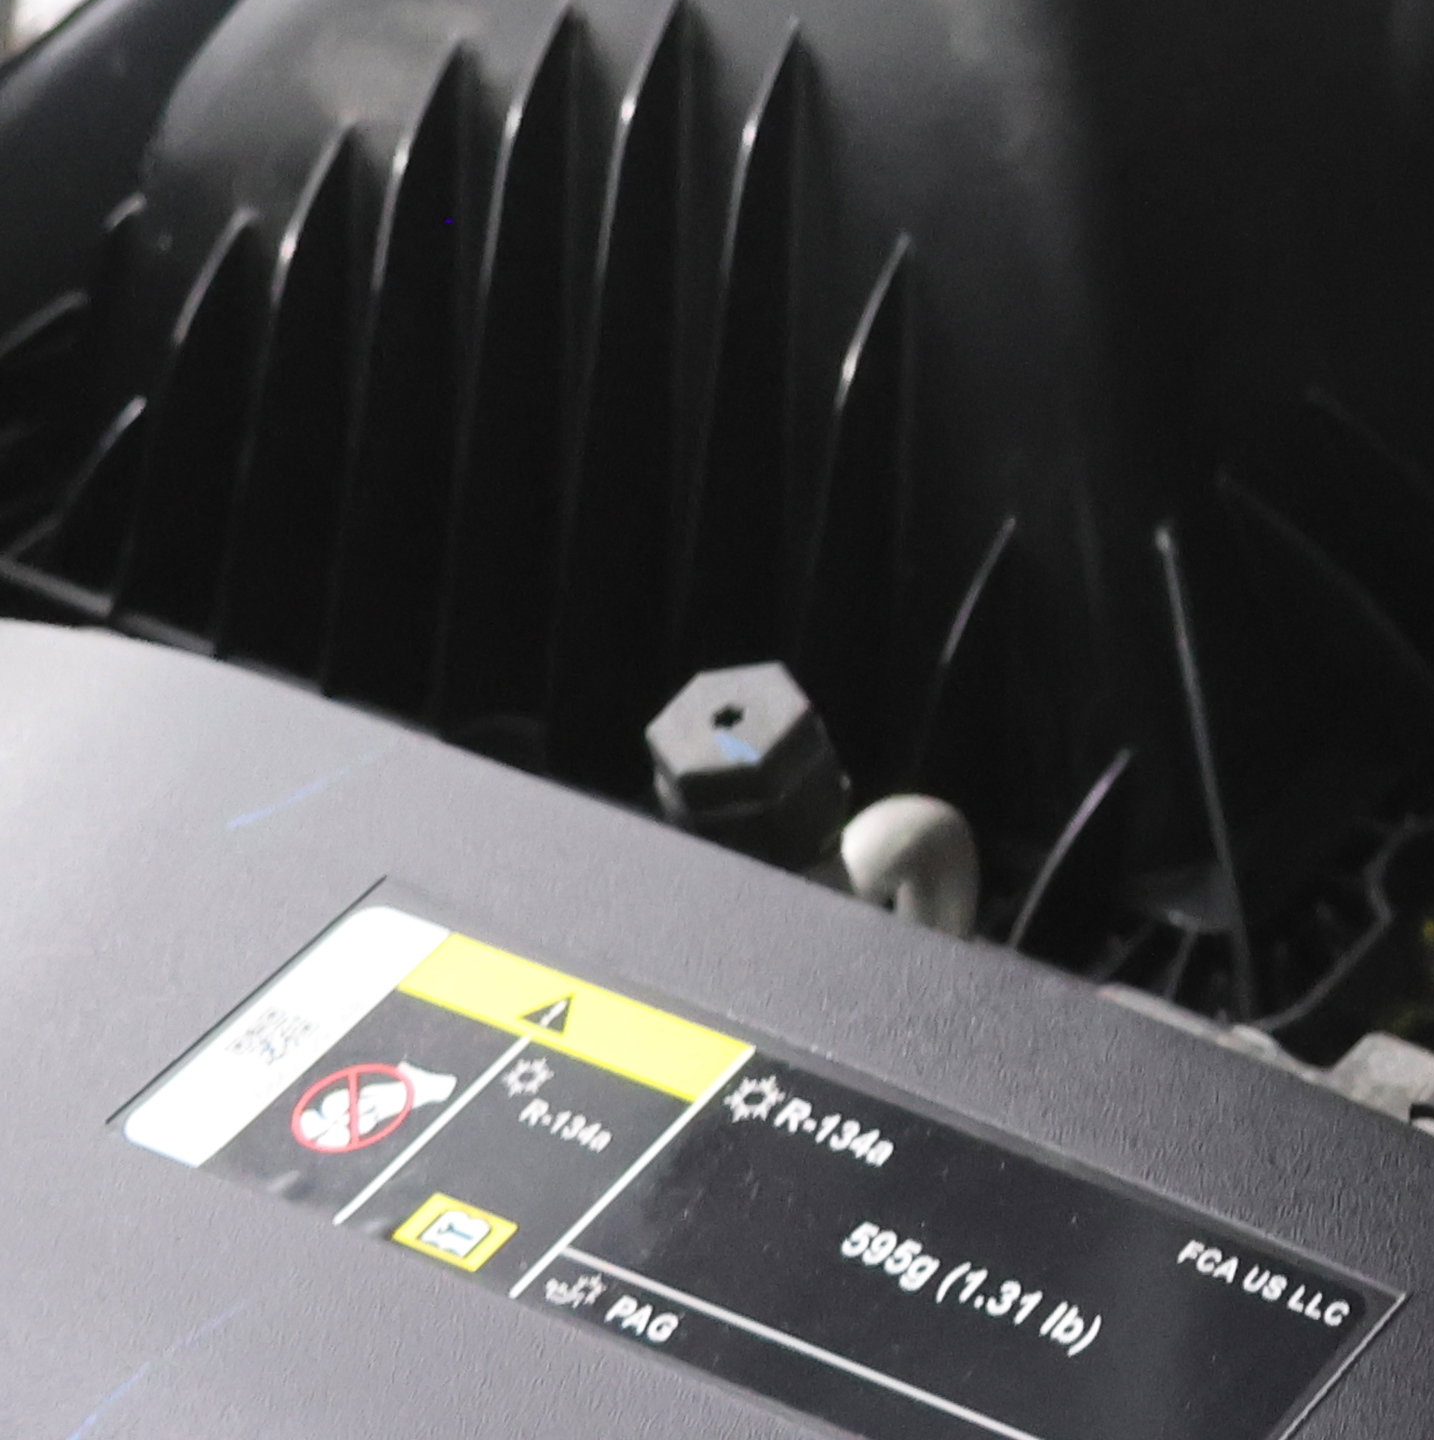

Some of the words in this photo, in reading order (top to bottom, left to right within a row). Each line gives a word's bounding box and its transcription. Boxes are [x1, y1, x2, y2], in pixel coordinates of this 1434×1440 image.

[518, 1097, 612, 1154] R-134a
[774, 1096, 895, 1167] R-134a
[604, 1294, 679, 1344] PAG
[840, 1221, 941, 1291] 595g
[936, 1262, 1043, 1325] (1.31
[1038, 1301, 1102, 1358] lb)
[1177, 1240, 1240, 1284] FCA
[1243, 1265, 1289, 1301] US
[1286, 1285, 1350, 1328] LLC
